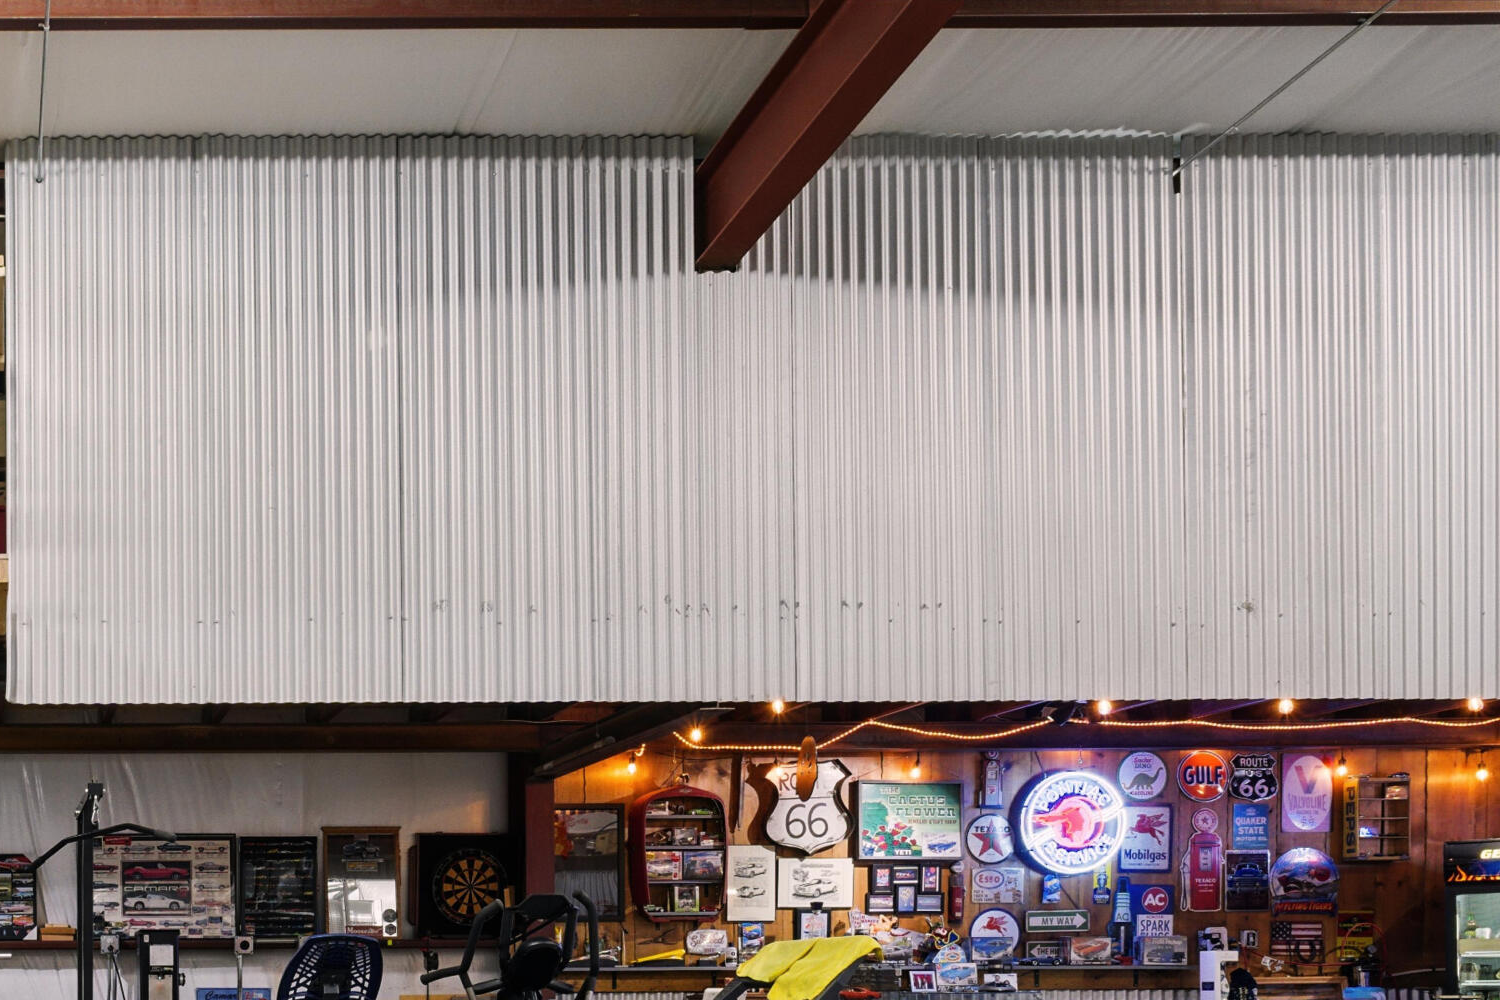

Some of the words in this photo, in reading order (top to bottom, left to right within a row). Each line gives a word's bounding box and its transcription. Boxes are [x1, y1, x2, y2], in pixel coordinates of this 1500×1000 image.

[1240, 757, 1268, 768] ROUTE
[1184, 765, 1224, 785] GULF
[1240, 780, 1269, 796] 66
[888, 796, 946, 805] CACTUS
[895, 807, 956, 817] FLOWER
[785, 803, 829, 839] 66
[1235, 817, 1267, 826] QUAKER
[1346, 787, 1356, 854] PEPSI
[974, 825, 1012, 834] TEXACO
[1238, 826, 1265, 835] STATE
[1124, 848, 1167, 863] Mobilgas
[1144, 893, 1165, 906] AC
[1041, 917, 1054, 925] MY
[1056, 917, 1075, 925] WAY
[1116, 913, 1129, 921] AC
[1140, 919, 1170, 932] SPARK
[1036, 947, 1049, 956] THE
